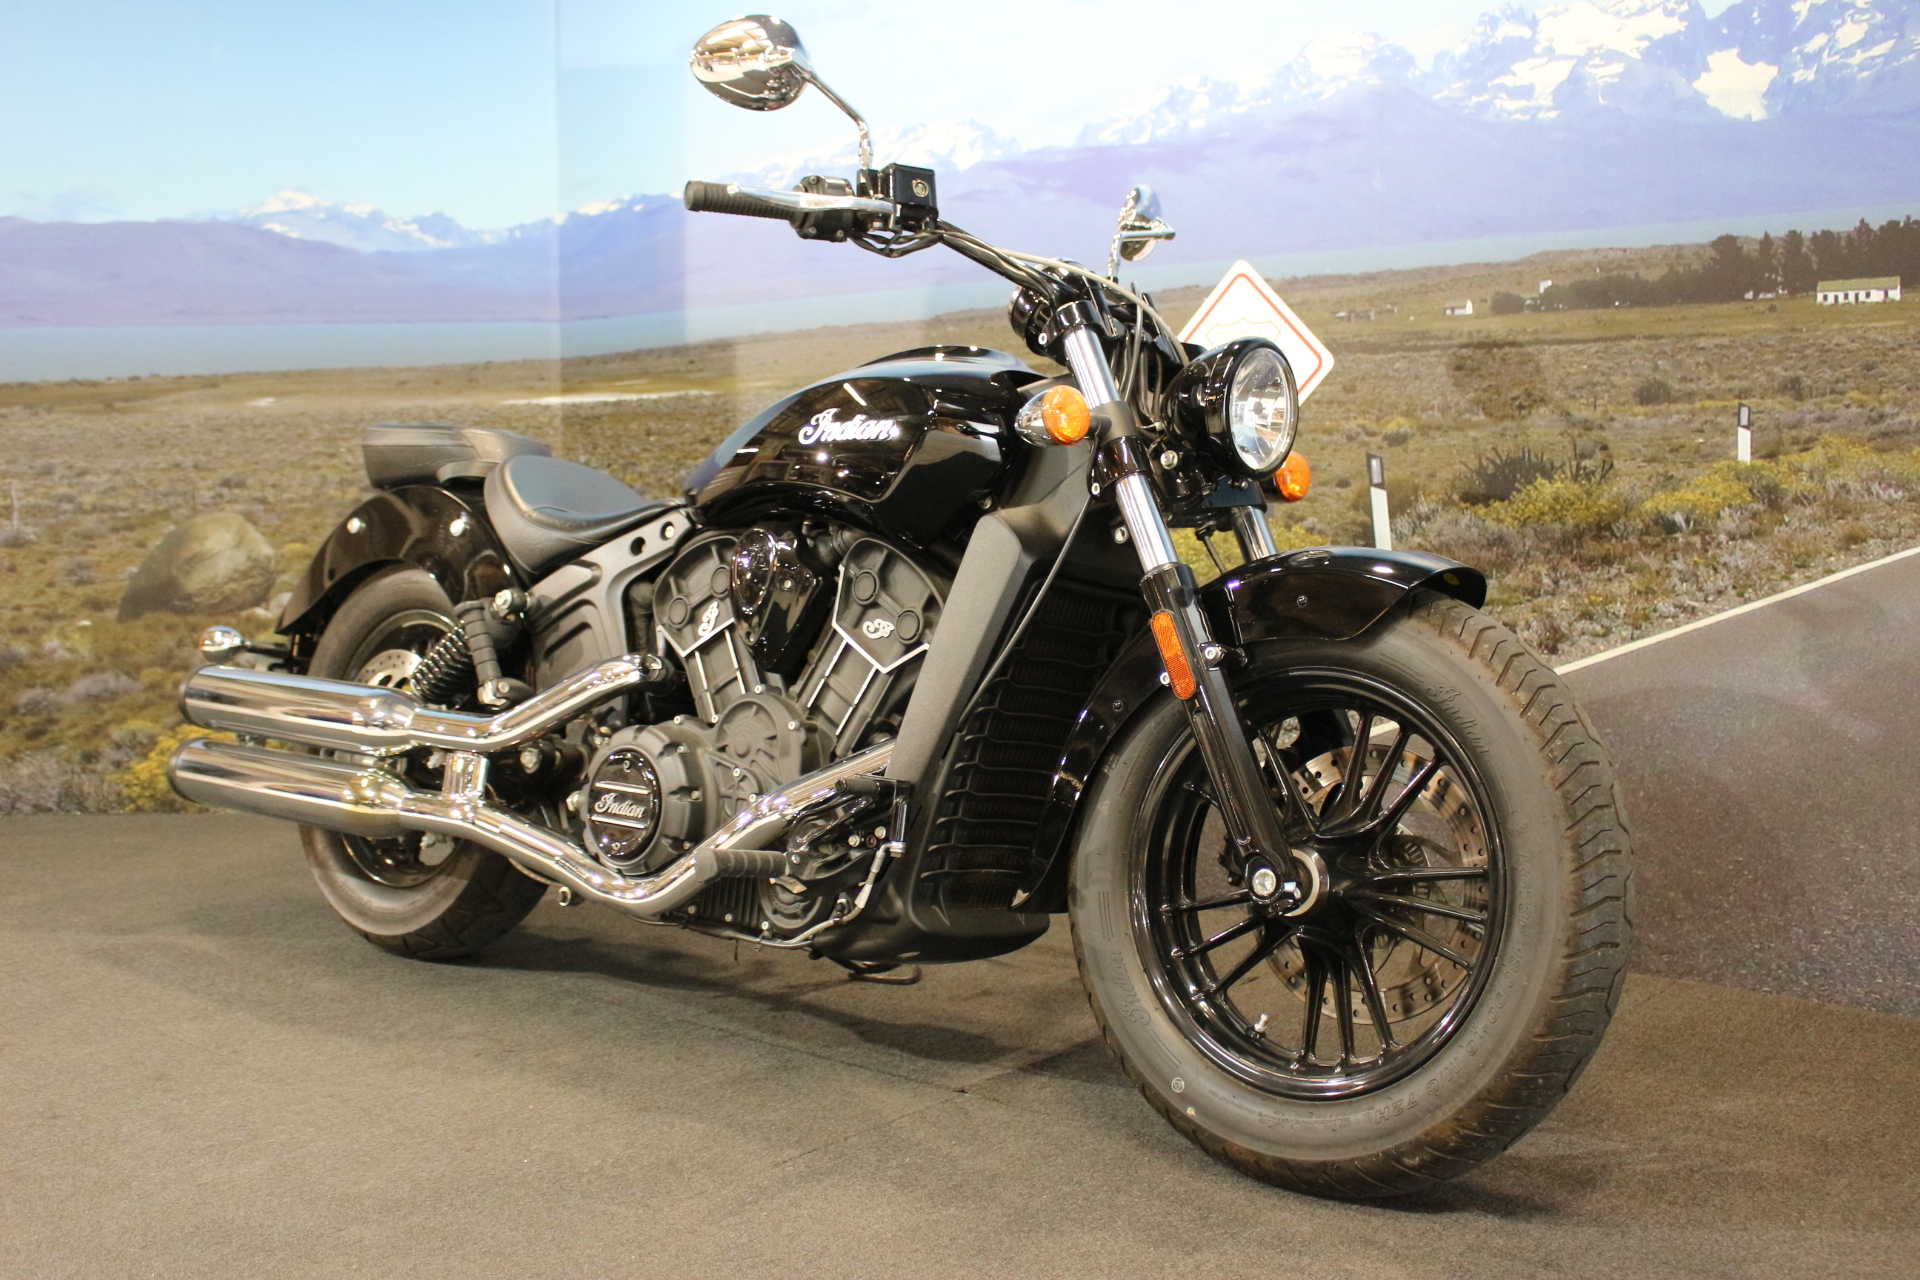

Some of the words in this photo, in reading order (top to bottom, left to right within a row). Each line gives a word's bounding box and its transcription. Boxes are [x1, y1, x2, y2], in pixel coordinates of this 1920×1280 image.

[798, 407, 897, 445] Indian
[1425, 683, 1490, 754] Indian
[594, 792, 645, 818] Indian
